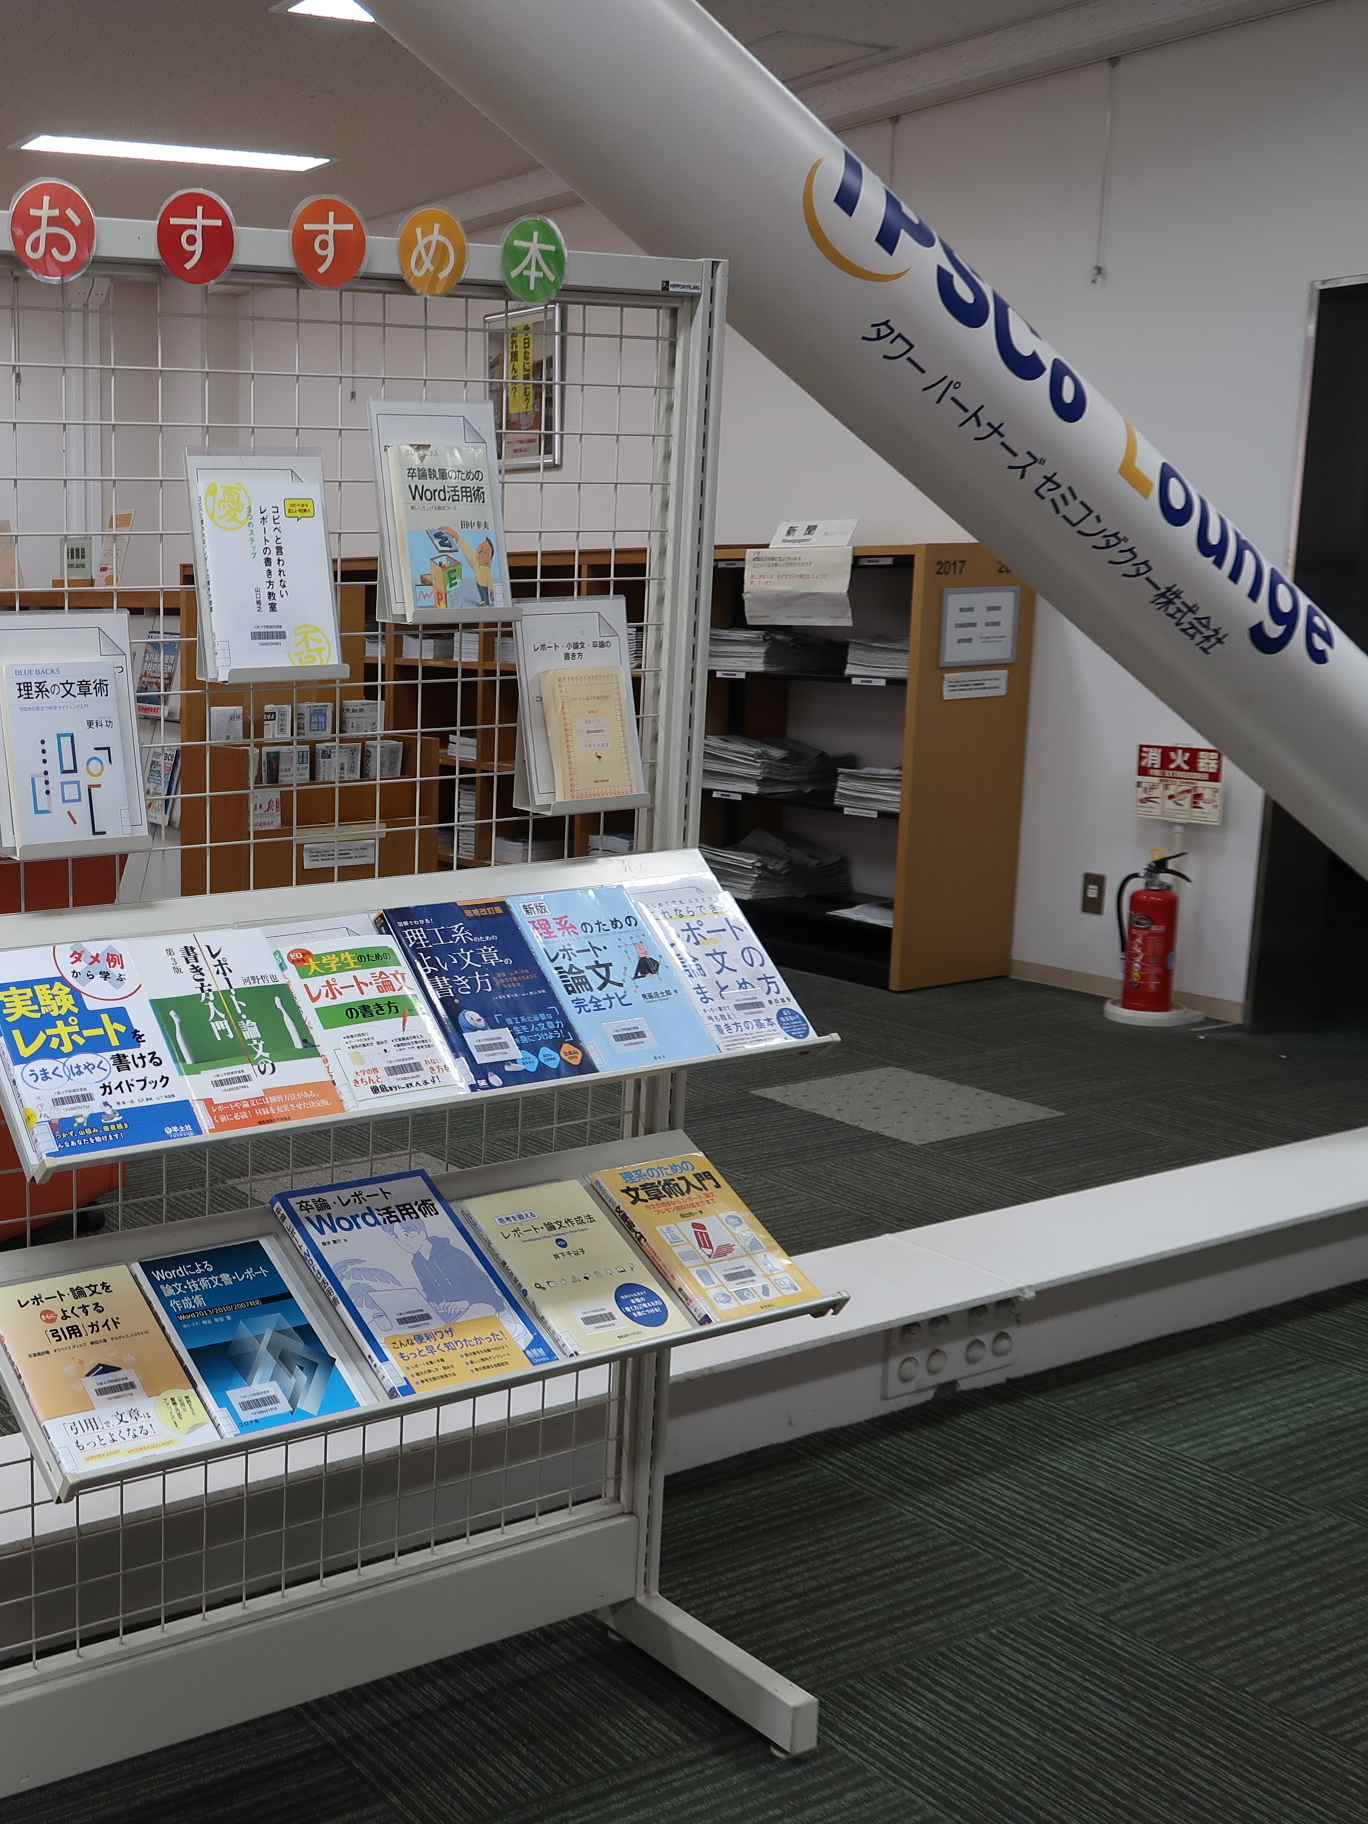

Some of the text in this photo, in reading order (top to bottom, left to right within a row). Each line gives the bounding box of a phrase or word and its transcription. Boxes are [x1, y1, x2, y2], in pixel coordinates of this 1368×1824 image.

[406, 467, 484, 482] 卒論執筆のための
[861, 318, 1230, 656] タワー パートナーズ セミコンダクター株式会社
[408, 484, 486, 504] Word活用術
[246, 505, 257, 560] 3つのステップ
[460, 520, 490, 531] 田中幸夫
[271, 505, 289, 598] コピペと言われない
[1118, 418, 1335, 665] Lounge
[259, 505, 278, 613] レポートの書き方教室
[936, 560, 966, 575] 2017
[447, 568, 458, 588] E
[532, 640, 612, 652] レポート・小論文・卒論の
[563, 651, 583, 661] 書き方
[14, 667, 61, 676] BLUE BACKS
[16, 678, 110, 701] 理系の文章術
[1141, 747, 1219, 773] 消火器
[521, 903, 550, 916] 新版
[650, 902, 732, 921] これならでき
[404, 922, 498, 950] 理工系のための
[528, 915, 638, 940] 理系のための
[69, 950, 125, 970] ダメ例
[165, 947, 184, 974] 第3版
[305, 951, 392, 976] 大学生のための
[417, 945, 513, 975] よい文章の
[544, 941, 608, 963] レポート・
[677, 946, 766, 979] 論文の
[71, 969, 127, 982] から学ぶ
[241, 973, 279, 986] 河野哲也
[303, 969, 415, 1004] レポート・論文
[430, 972, 493, 999] 書き方
[555, 961, 625, 996] 論文
[180, 945, 234, 1041] 書き方入門
[693, 973, 781, 1005] まとめ方
[204, 944, 276, 1076] レポート・論文の
[345, 1001, 400, 1020] の書き方
[571, 991, 633, 1015] 完全ナビ
[11, 1012, 147, 1058] レポート を
[28, 1050, 164, 1083] うまく はやく 書ける
[99, 1073, 170, 1097] ガイドブック
[353, 1075, 383, 1088] きちんと
[172, 1124, 193, 1133] 羊土社
[619, 1160, 695, 1184] 理系のための
[295, 1186, 392, 1214] 卒論・レポート
[620, 1170, 722, 1206] 文章術入門
[305, 1198, 440, 1236] Word活用術
[497, 1211, 536, 1225] 思考を鍛える
[500, 1214, 597, 1240] レポート・論文作成法
[553, 1248, 586, 1261] 井下千以子
[151, 1260, 214, 1282] Wordによる
[159, 1266, 269, 1298] 論文・技術文書・レポート
[16, 1280, 113, 1309] レポート・論文を
[169, 1294, 207, 1313] 作成術
[40, 1312, 57, 1322] さらに
[60, 1302, 105, 1320] よくする
[44, 1316, 121, 1344] 「引用」ガイド
[390, 1327, 455, 1350] こんな便利ワザ
[397, 1329, 508, 1362] もっと早く知りたかった!
[62, 1407, 152, 1437] 「引用」で、文章は
[239, 1419, 261, 1428] コロナ社
[74, 1424, 157, 1450] もっとよくなる!
